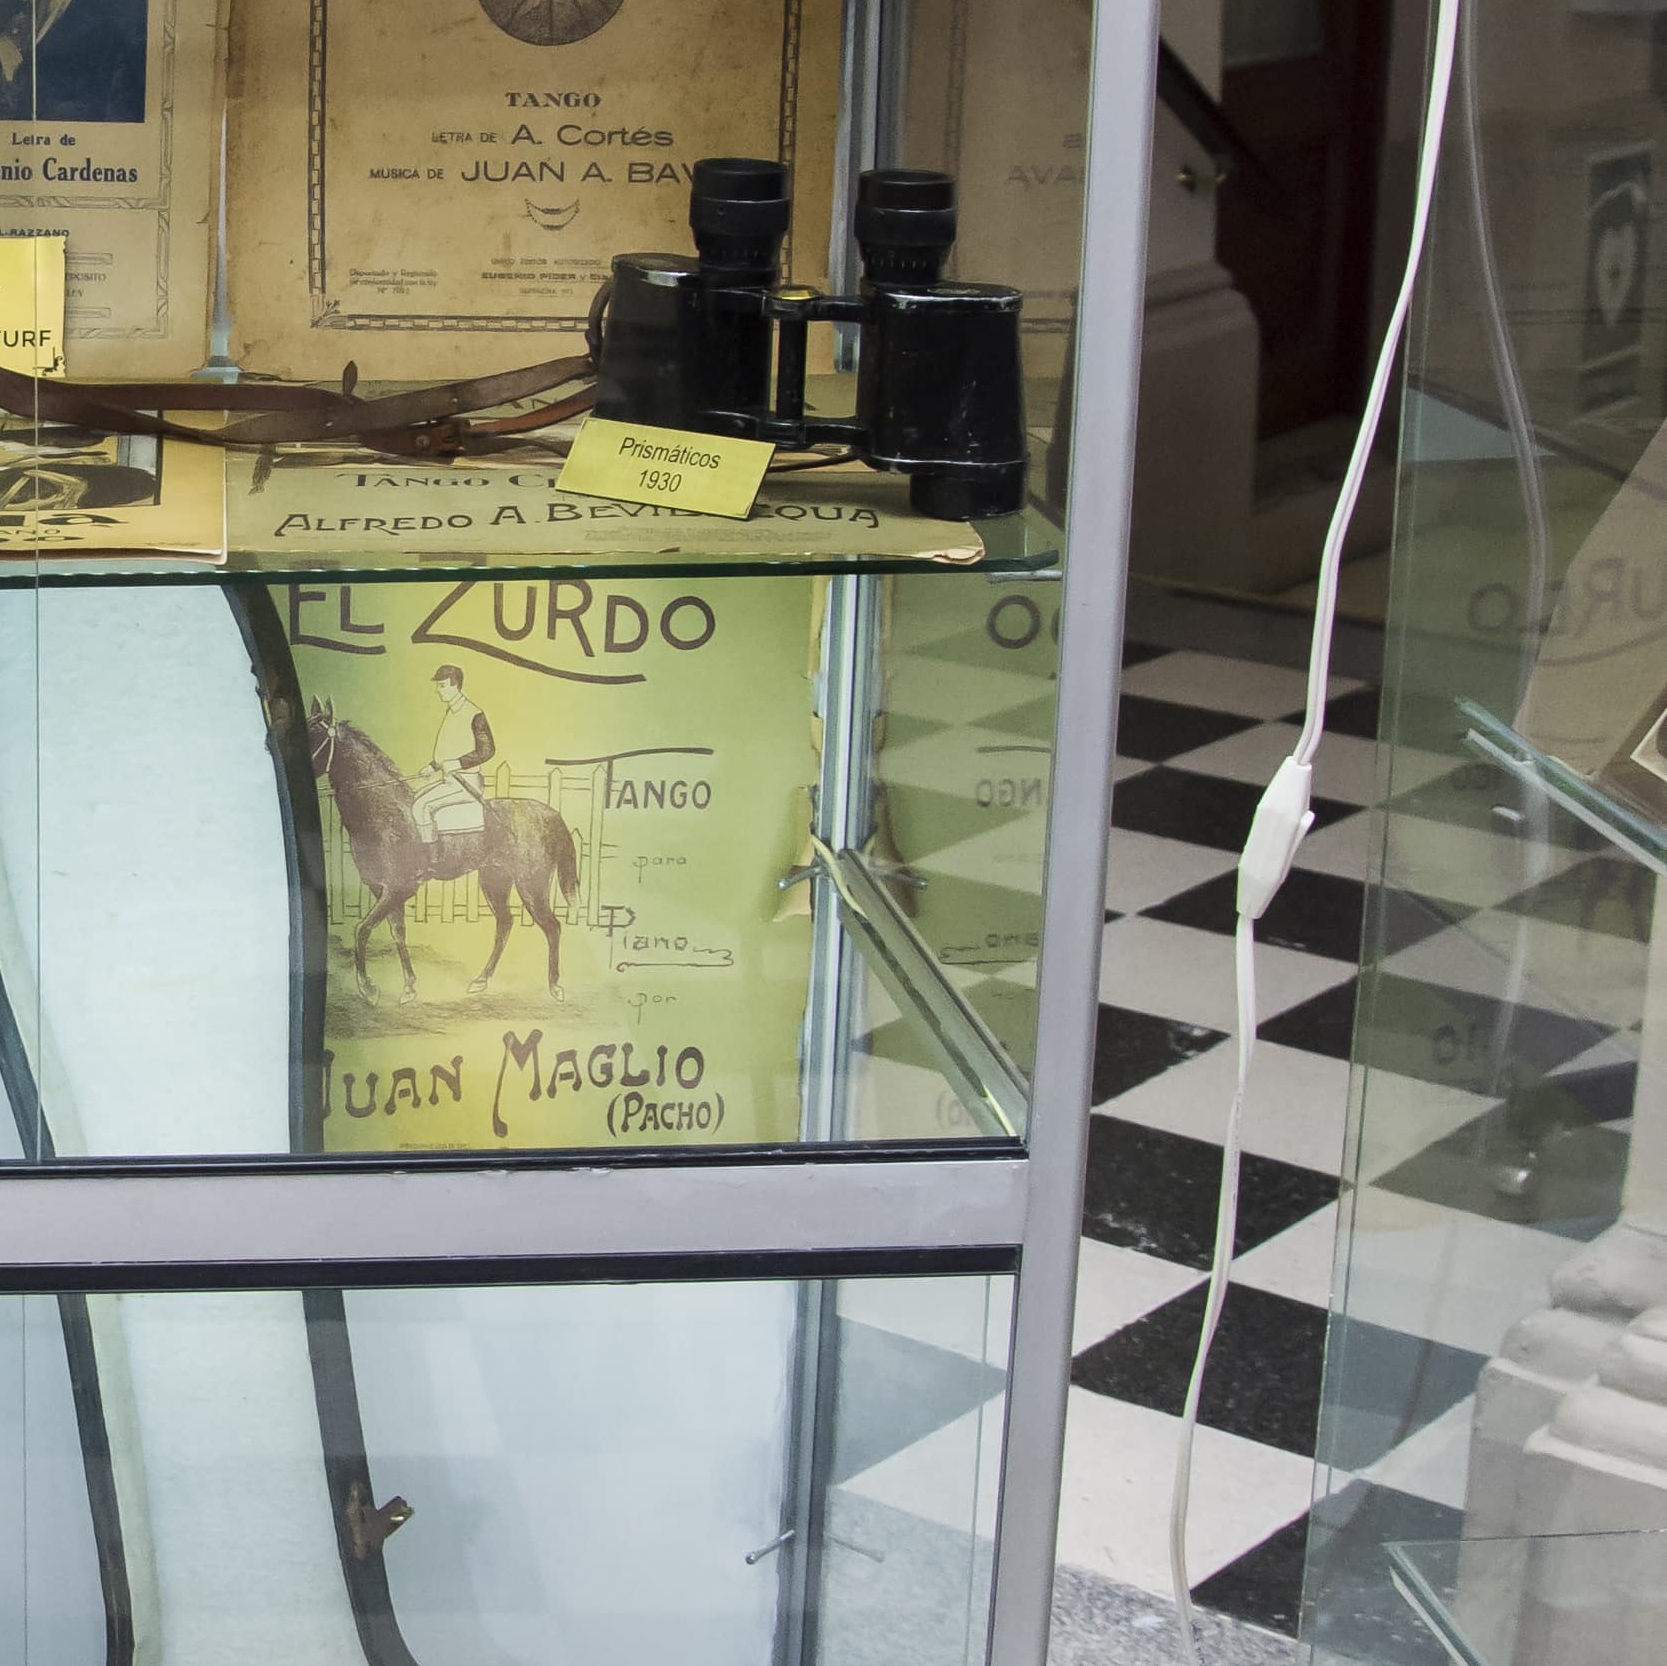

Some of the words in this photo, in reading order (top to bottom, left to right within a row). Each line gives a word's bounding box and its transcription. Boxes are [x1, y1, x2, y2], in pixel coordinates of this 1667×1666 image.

[505, 92, 603, 108] TANGO
[12, 133, 51, 148] Letra
[59, 134, 76, 148] de
[431, 131, 473, 144] LETRA
[480, 132, 498, 143] DE
[511, 124, 543, 145] A.
[556, 123, 674, 147] Cortés
[42, 158, 138, 184] Cardenas
[369, 168, 421, 180] MUSICA
[427, 169, 444, 179] DE
[461, 160, 565, 182] JUAN
[580, 161, 613, 183] A.
[619, 436, 721, 469] Prismáticos
[337, 473, 490, 488] TANGO
[638, 469, 683, 493] 1930
[274, 513, 473, 537] ALFREDO
[410, 578, 717, 684] ZURDO
[544, 747, 715, 811] TANGO
[597, 904, 690, 969] Piano
[492, 1028, 705, 1139] MAGLIO
[605, 1090, 725, 1138] (PACHO)
